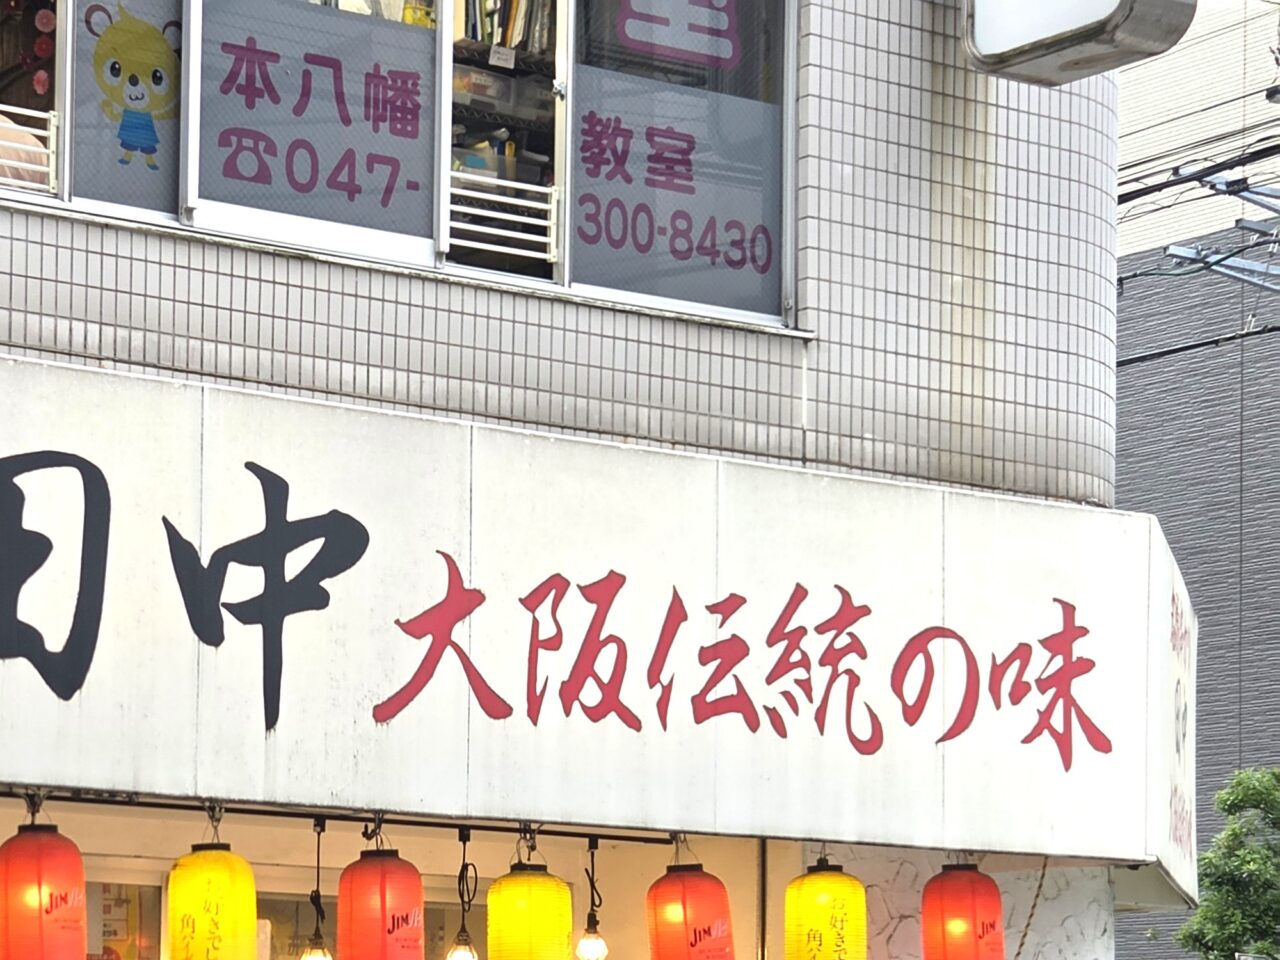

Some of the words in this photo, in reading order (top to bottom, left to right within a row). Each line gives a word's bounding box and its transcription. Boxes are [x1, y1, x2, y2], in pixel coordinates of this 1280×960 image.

[219, 36, 422, 140] 本八幡
[579, 111, 697, 195] 教室
[577, 193, 773, 275] 300-8430
[373, 550, 1113, 773] 大阪伝統の味
